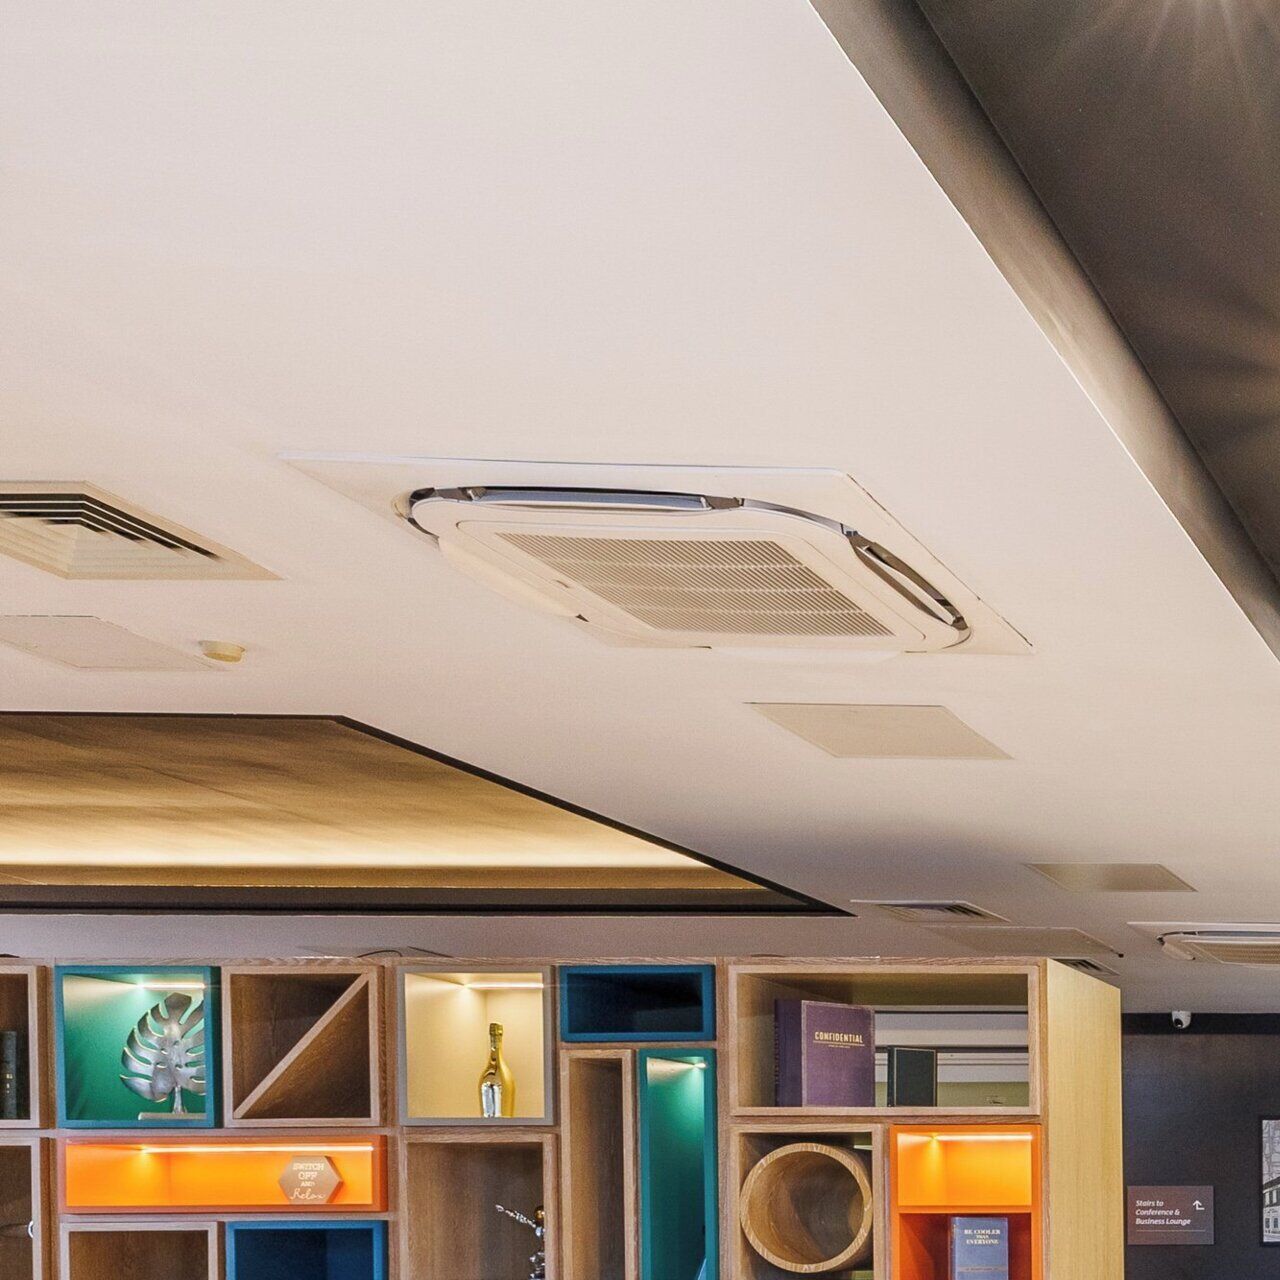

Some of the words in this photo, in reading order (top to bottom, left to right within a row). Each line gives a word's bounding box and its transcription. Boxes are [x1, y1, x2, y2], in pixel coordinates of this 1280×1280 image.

[814, 1031, 864, 1043] CONFIDENTIAL
[298, 1171, 318, 1180] OFF
[1135, 1208, 1174, 1216] Conference
[1166, 1218, 1191, 1226] Lounge
